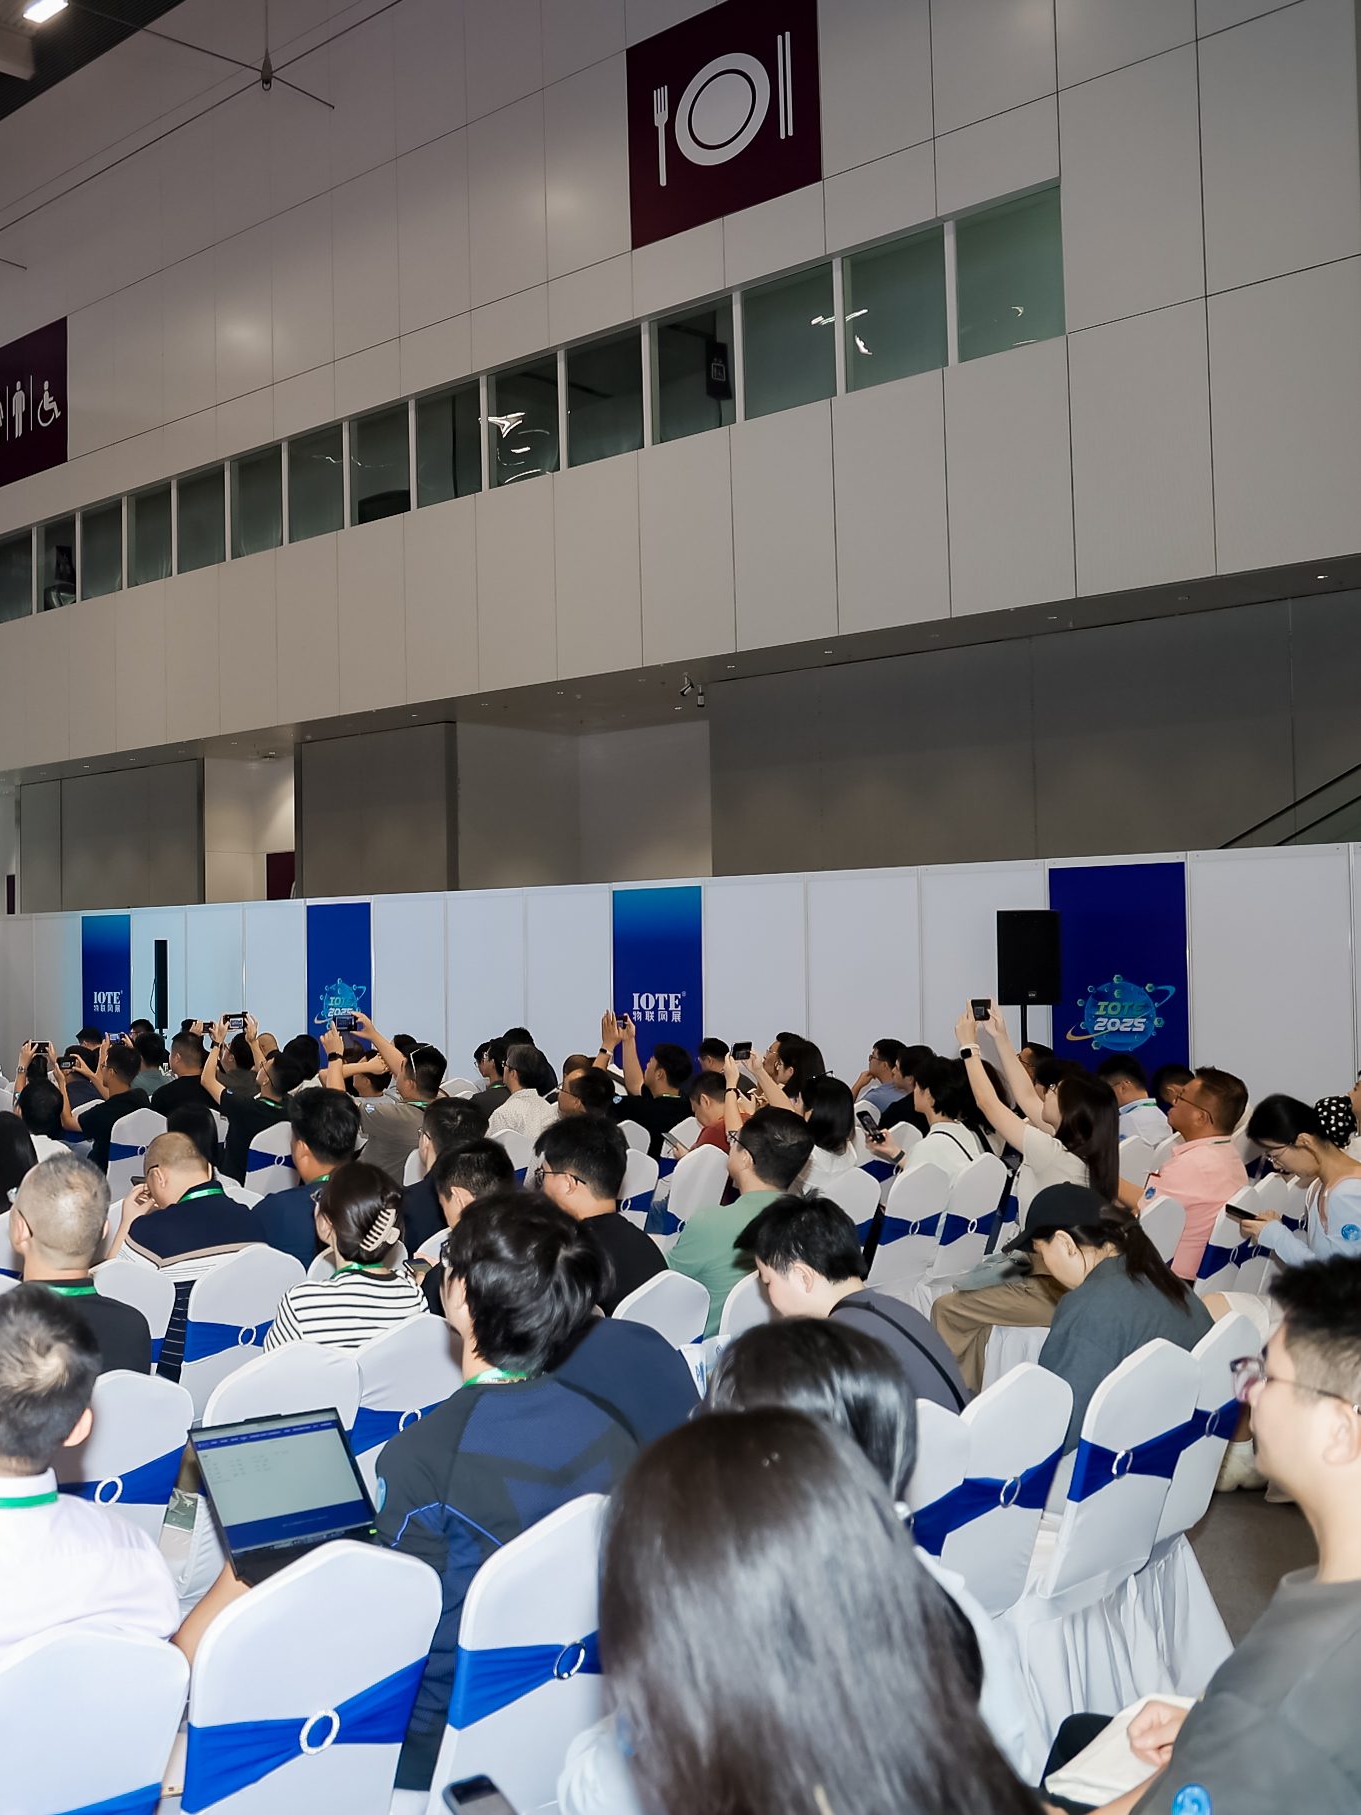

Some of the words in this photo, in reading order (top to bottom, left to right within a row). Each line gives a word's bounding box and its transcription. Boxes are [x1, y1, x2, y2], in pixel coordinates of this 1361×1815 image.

[1095, 1002, 1145, 1015] IOTE
[633, 1011, 681, 1022] 物联网展
[1094, 1018, 1146, 1031] 2025
